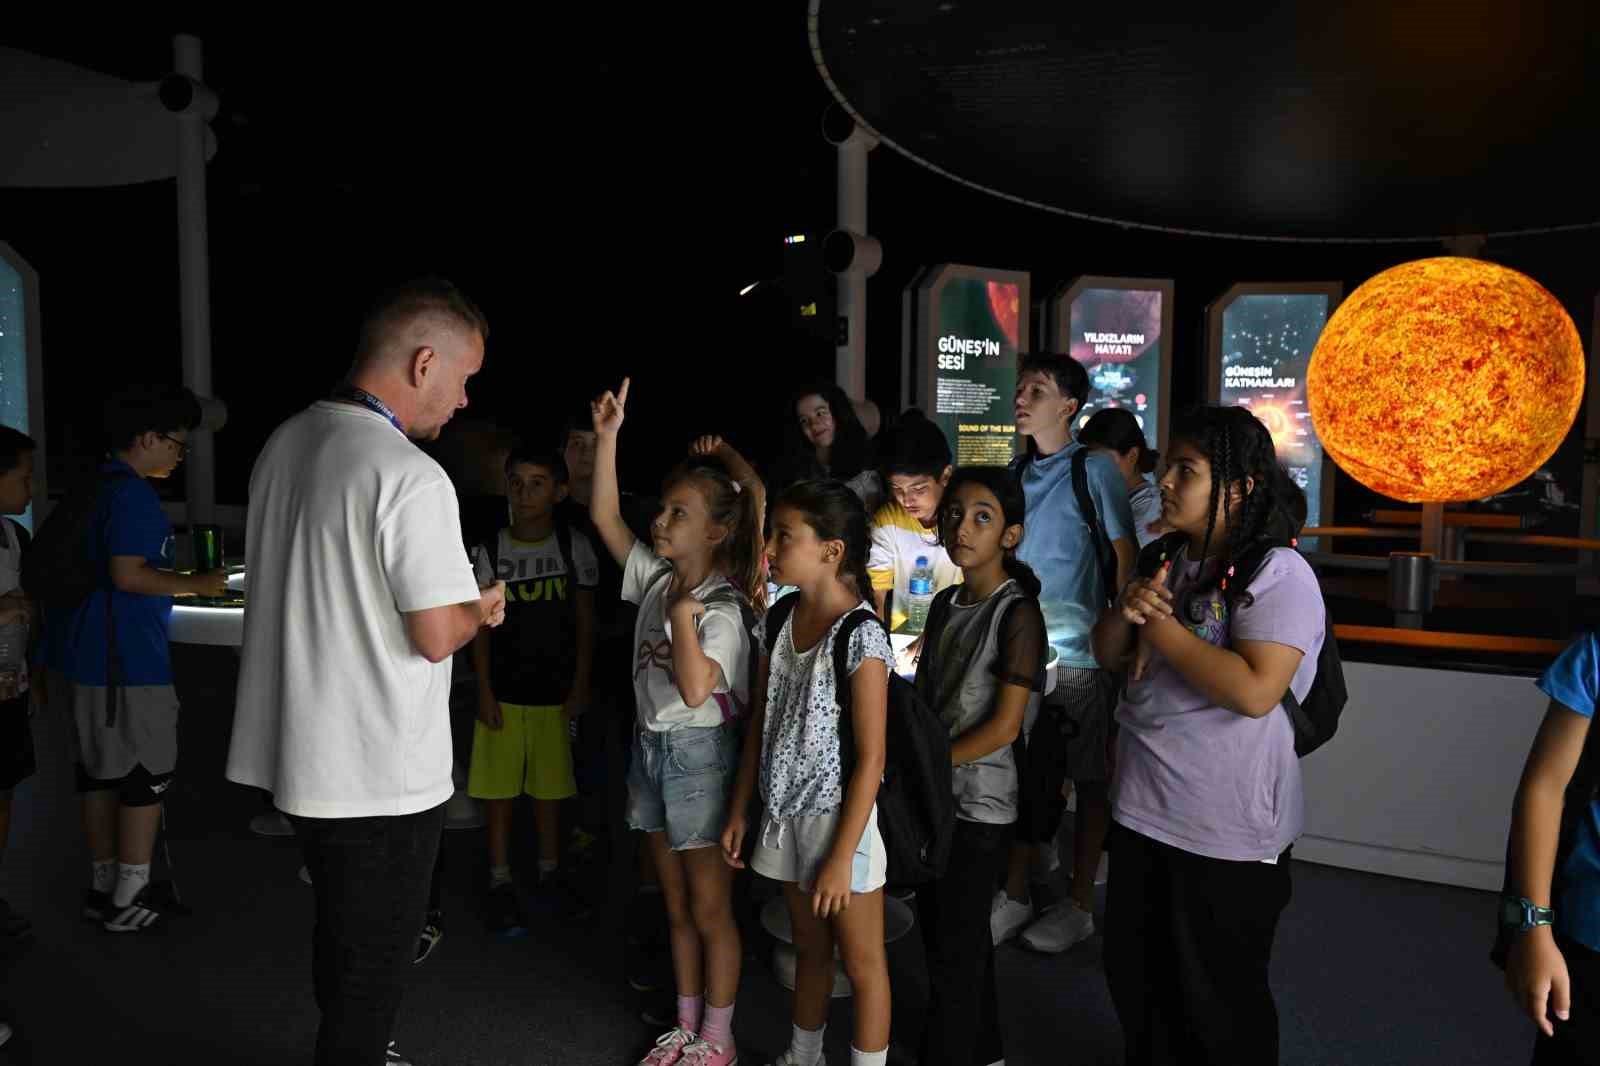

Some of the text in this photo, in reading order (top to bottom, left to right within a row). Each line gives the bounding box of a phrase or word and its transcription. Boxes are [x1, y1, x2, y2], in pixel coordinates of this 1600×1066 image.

[1084, 332, 1145, 345] YILDIZLARIN
[938, 335, 1000, 357] GÜNEŞ'İN
[1095, 344, 1132, 356] HAYATI
[937, 352, 965, 371] SESİ
[1225, 378, 1296, 388] KATMANLARI
[980, 425, 989, 433] OF
[990, 425, 1002, 433] THE
